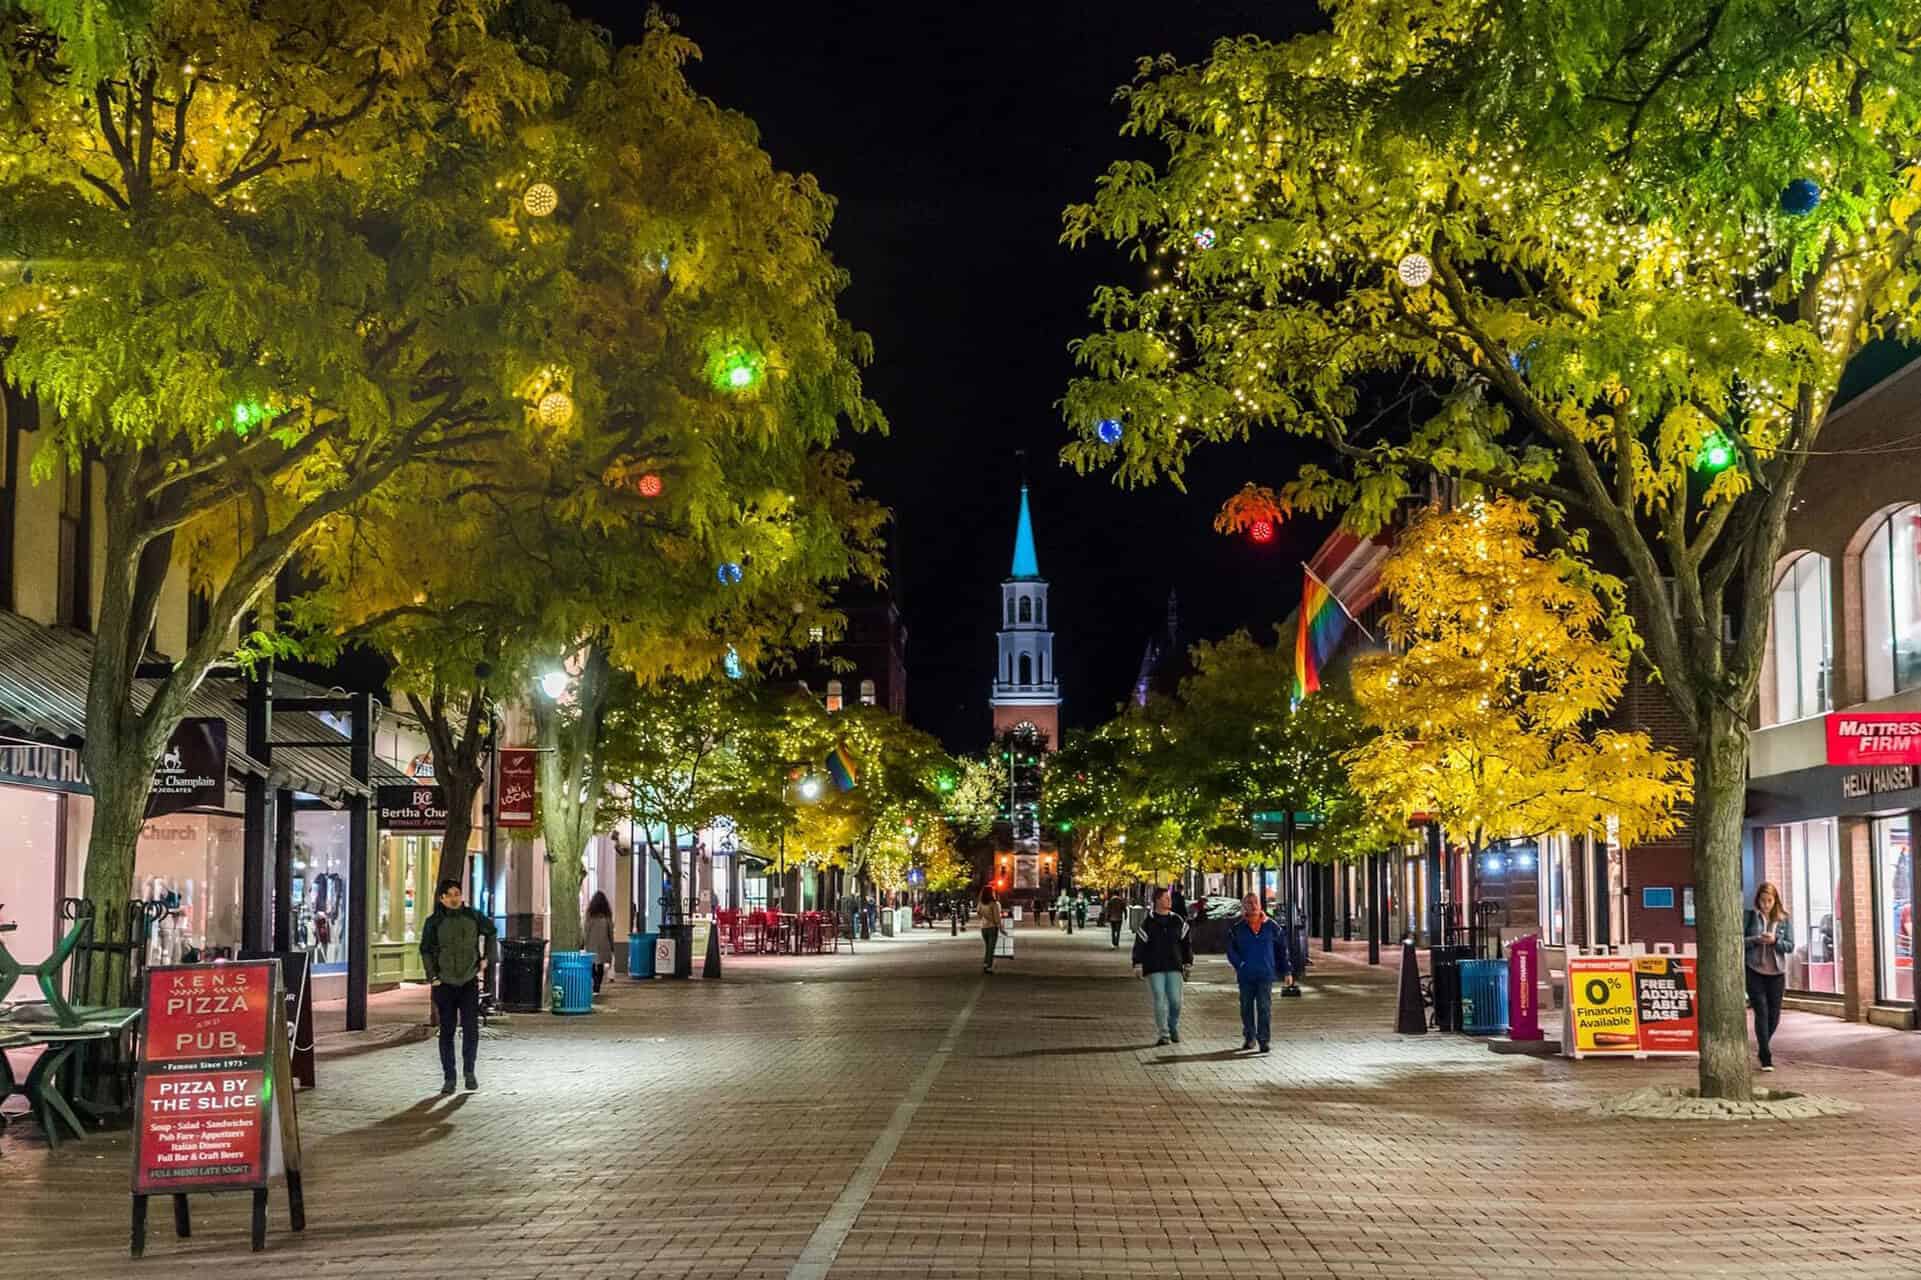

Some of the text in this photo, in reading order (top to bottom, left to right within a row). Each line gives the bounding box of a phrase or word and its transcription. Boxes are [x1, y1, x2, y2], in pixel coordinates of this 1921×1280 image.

[1839, 720, 1921, 736] MATTRES
[1859, 735, 1911, 752] FIRM
[166, 775, 215, 788] Champlain
[1842, 764, 1913, 798] HELLY HANSEN
[501, 791, 532, 805] LOCAL
[382, 808, 420, 817] Bertha
[173, 974, 247, 988] KEN'S
[1639, 979, 1676, 990] FREE
[1640, 990, 1697, 1000] ADJUST
[167, 995, 249, 1016] PIZZA
[1577, 1006, 1632, 1017] Financing
[1642, 1010, 1680, 1020] BASE
[1580, 1017, 1630, 1028] Available
[176, 1031, 237, 1051] PUB
[167, 1063, 198, 1071] Famous
[200, 1061, 221, 1069] Since
[160, 1079, 248, 1096] PIZZA BY
[150, 1095, 257, 1112] THE SLICE
[150, 1119, 254, 1133] Soup Salad Sandwiches
[159, 1133, 175, 1142] Pub
[157, 1154, 173, 1162] Full
[174, 1153, 189, 1161] Bar
[199, 1151, 219, 1160] Craft
